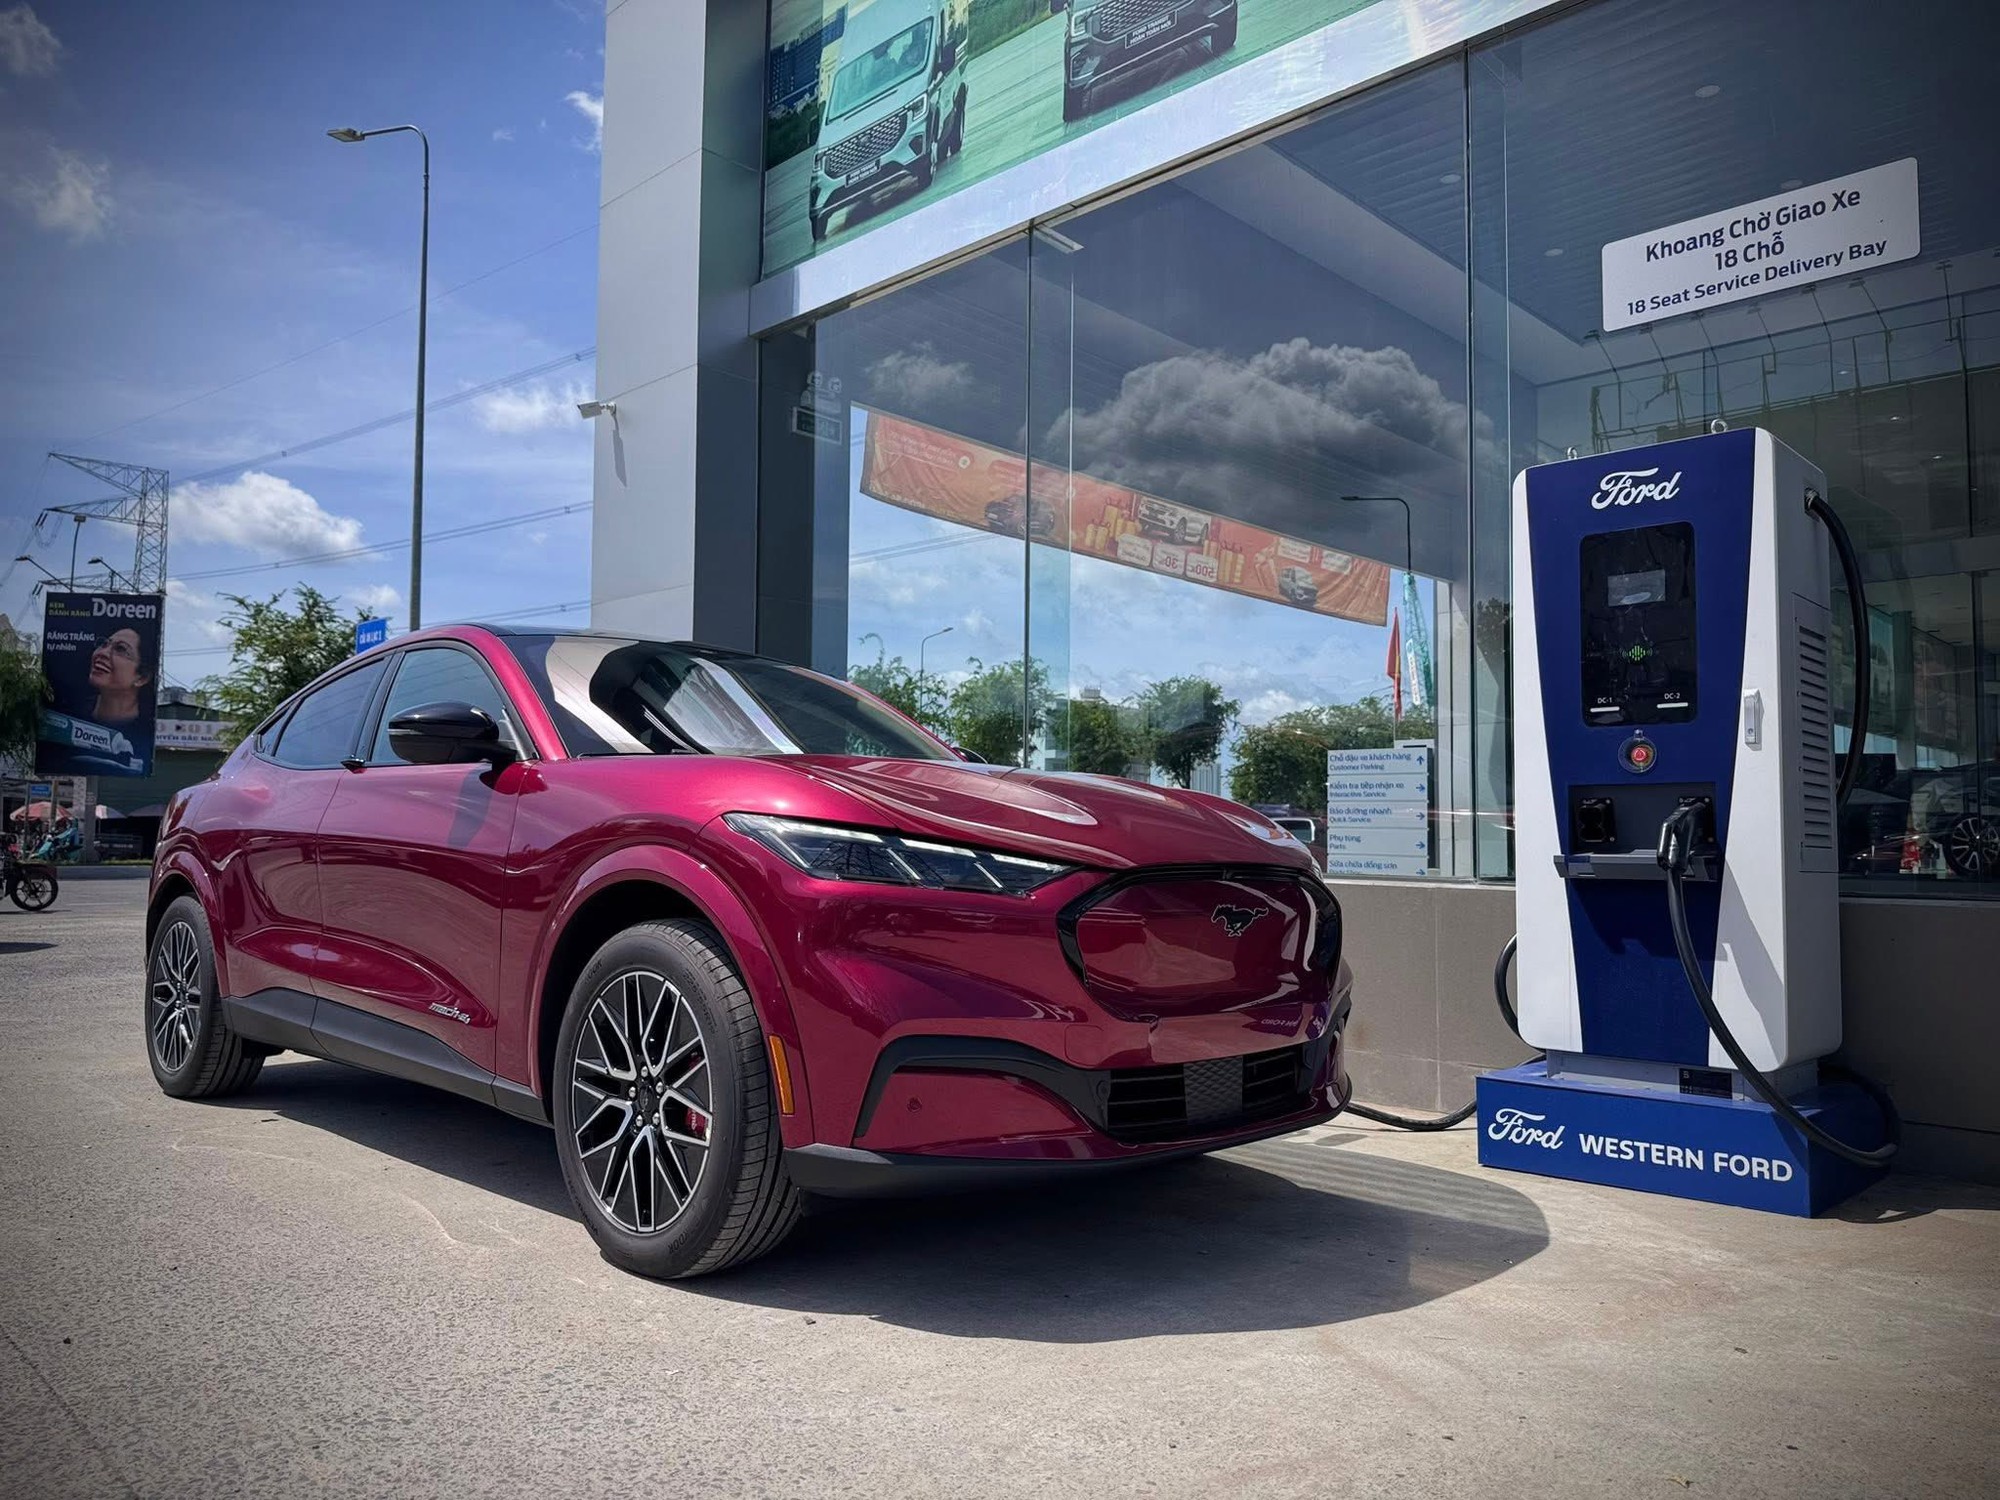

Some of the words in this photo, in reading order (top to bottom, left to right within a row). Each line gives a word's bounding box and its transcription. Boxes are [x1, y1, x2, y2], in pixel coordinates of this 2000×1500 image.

[1132, 26, 1147, 37] FORD
[1147, 14, 1170, 30] TRANSIT
[1646, 226, 1726, 262] Khoang
[1728, 210, 1772, 239] Chờ
[1776, 201, 1826, 227] Giao
[1831, 189, 1861, 211] Xe
[1714, 250, 1738, 271] 18
[1742, 230, 1785, 264] Chỗ
[1627, 300, 1646, 315] 18
[1650, 288, 1691, 310] Seat
[1694, 272, 1760, 298] Service
[1764, 250, 1845, 281] Delivery
[1848, 240, 1887, 260] Bay
[1591, 467, 1682, 510] Ford
[92, 597, 156, 619] Doreen
[56, 642, 76, 651] nhiên
[1664, 692, 1680, 700] DC-2
[74, 726, 108, 745] Doreen
[1368, 807, 1392, 815] nhanh
[1487, 1108, 1566, 1150] Ford
[1578, 1133, 1704, 1170] WESTERN
[1713, 1152, 1793, 1182] FORD
